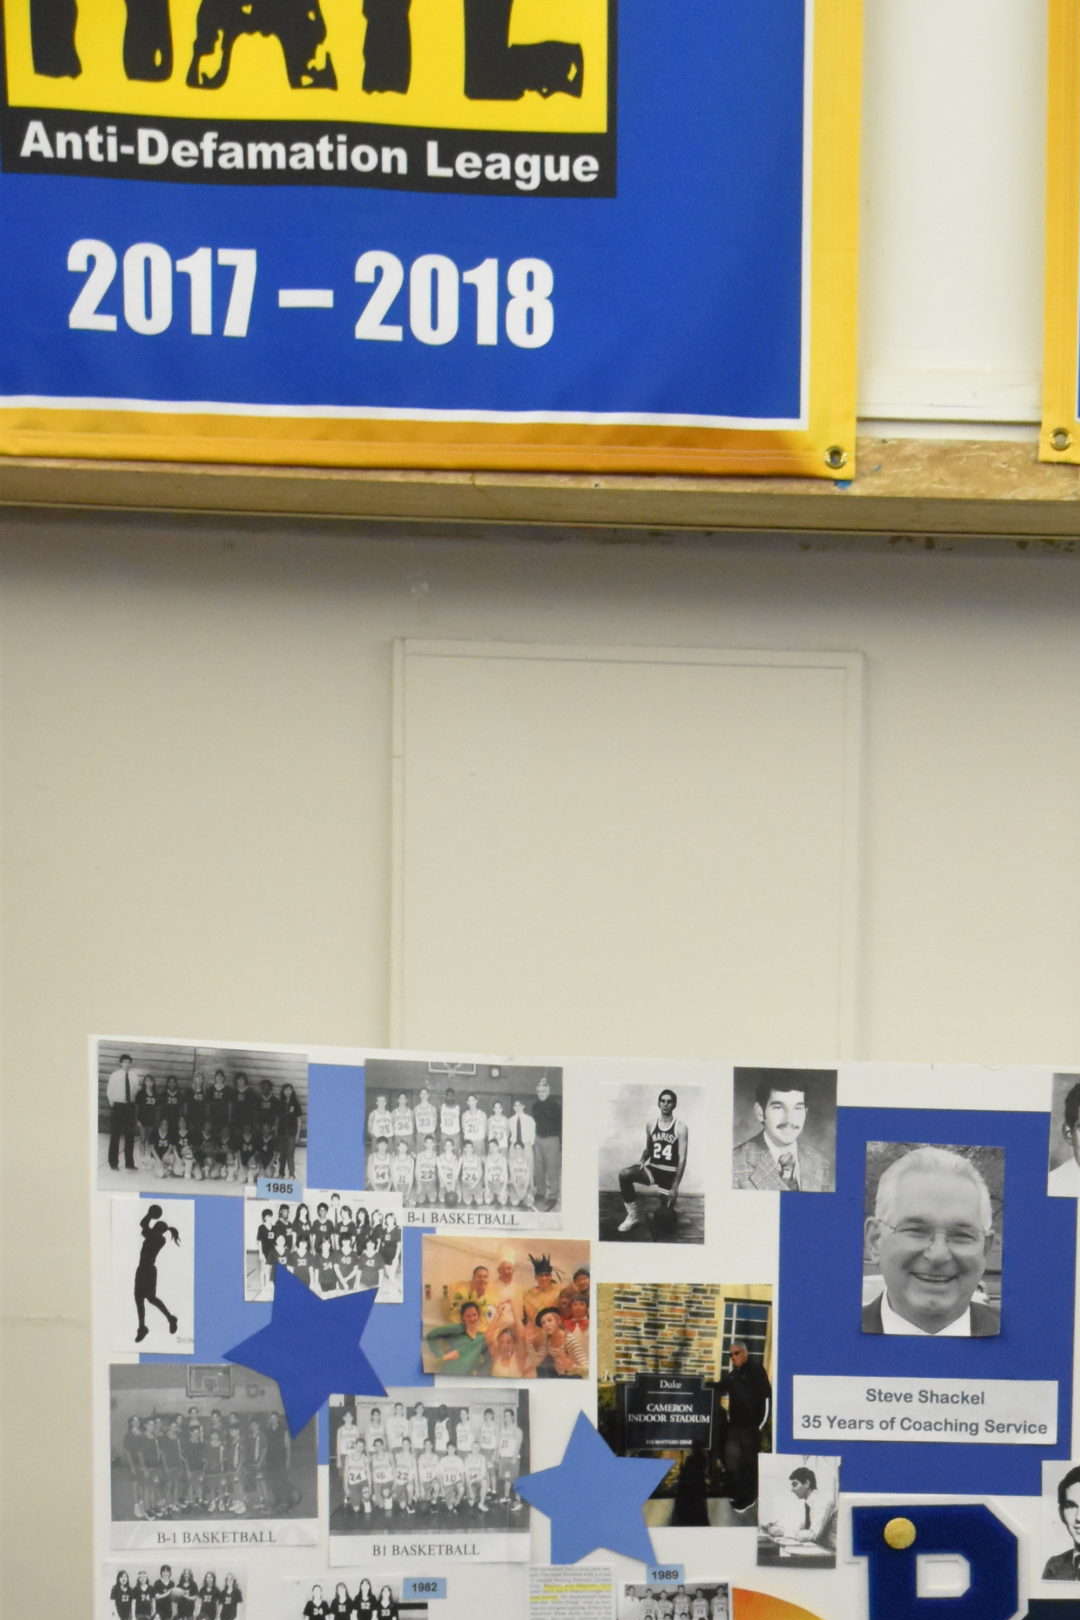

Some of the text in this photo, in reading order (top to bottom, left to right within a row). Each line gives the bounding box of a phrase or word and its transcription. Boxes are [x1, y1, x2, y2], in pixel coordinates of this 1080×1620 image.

[20, 121, 600, 192] Anti-Defamation League
[67, 238, 257, 338] 2017
[354, 251, 556, 349] 2018
[651, 1131, 677, 1146] MARIST
[653, 1142, 673, 1162] 24
[265, 1182, 293, 1194] 1985
[407, 1211, 519, 1226] B-1 BASKETBALL
[660, 1380, 682, 1389] Duke
[866, 1388, 985, 1405] Steve Shackel
[646, 1403, 694, 1413] CAMERON
[628, 1414, 711, 1423] INDOOR STADIUM
[801, 1415, 1048, 1436] 35 Years of Coaching Service
[183, 1531, 277, 1544] BASKETBALL
[391, 1544, 480, 1556] BASKETBALL
[651, 1570, 679, 1580] 1989
[411, 1582, 437, 1593] 1982
